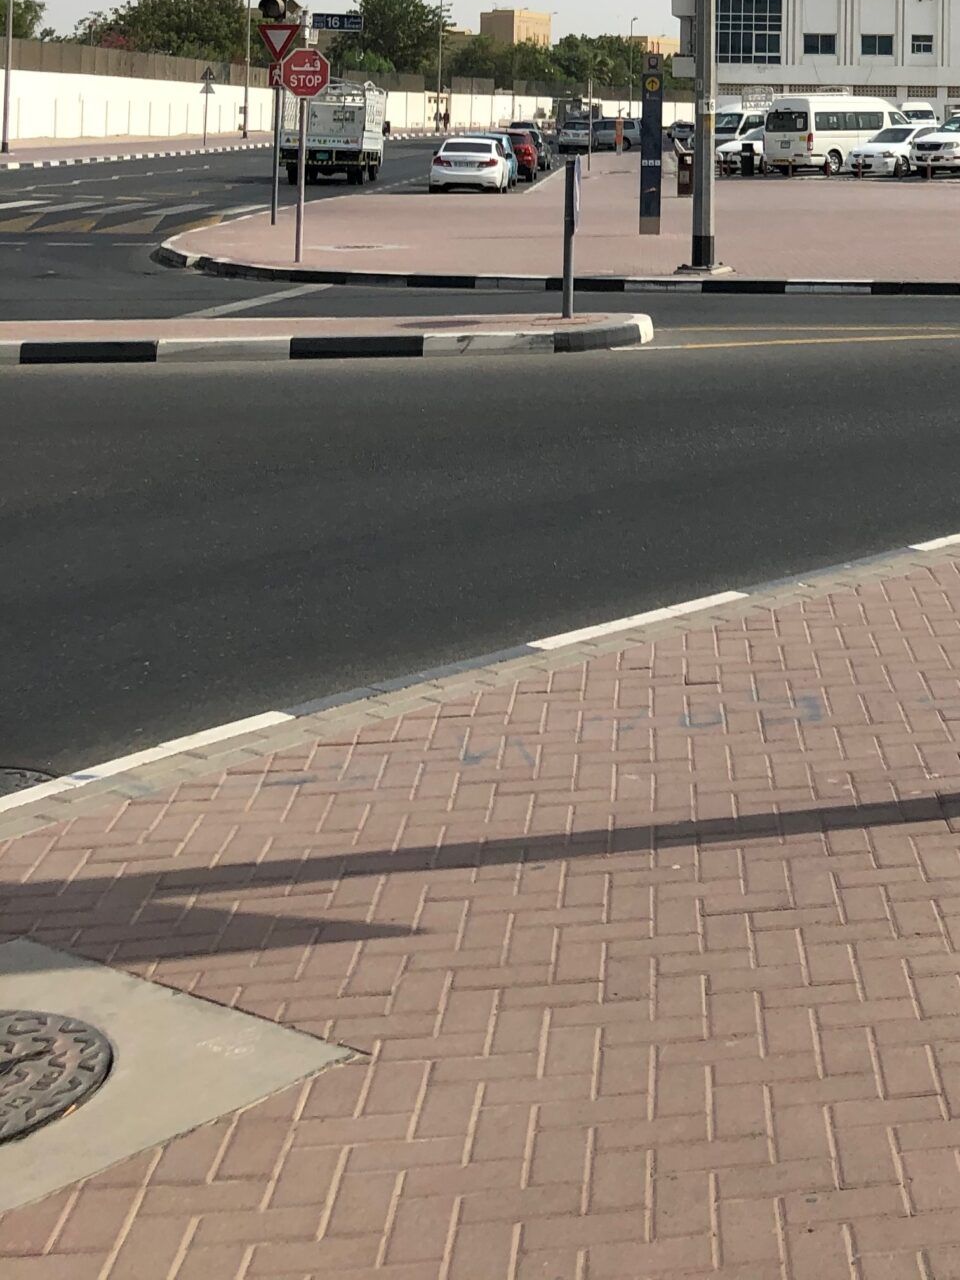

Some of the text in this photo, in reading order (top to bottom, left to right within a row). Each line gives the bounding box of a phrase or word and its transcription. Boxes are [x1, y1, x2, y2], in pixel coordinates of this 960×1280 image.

[326, 16, 340, 28] 16
[291, 56, 321, 71] قف
[290, 74, 322, 87] STOP
